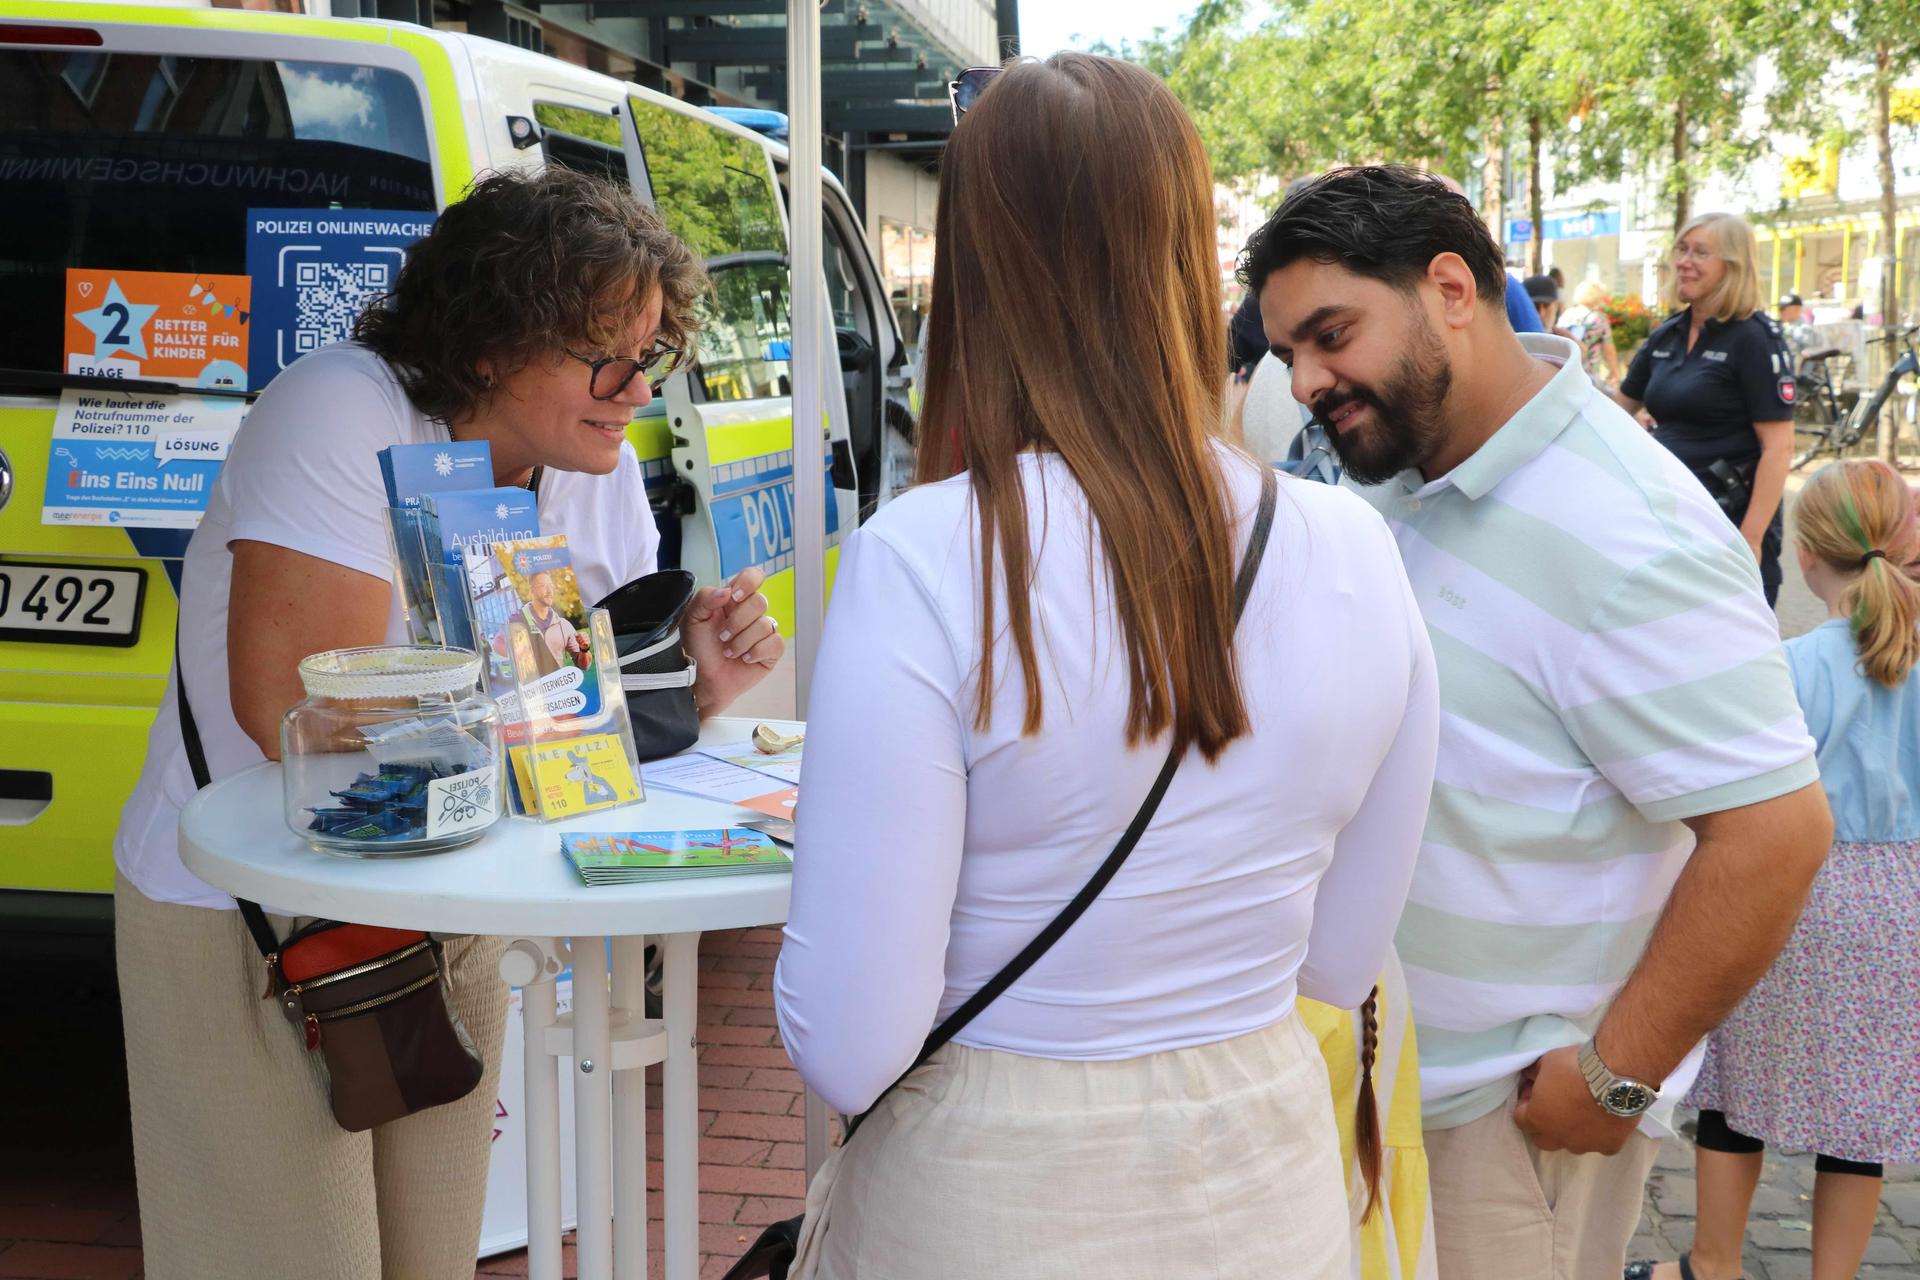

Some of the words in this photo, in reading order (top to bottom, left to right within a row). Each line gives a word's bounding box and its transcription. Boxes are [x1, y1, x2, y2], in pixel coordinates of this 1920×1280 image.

[255, 220, 312, 235] POLIZEI
[316, 220, 431, 237] ONLINEWACHE
[101, 302, 130, 345] 2
[154, 318, 208, 332] RETTER
[153, 332, 207, 347] RALLYE
[212, 332, 240, 347] FÜR
[153, 346, 206, 360] KINDER
[79, 366, 124, 379] FRAGE
[78, 397, 102, 408] Wie
[105, 398, 144, 410] lautet
[146, 401, 166, 410] die
[74, 409, 170, 424] Notrufnummer
[174, 413, 195, 424] der
[71, 422, 123, 435] Polizei?
[126, 424, 150, 435] 110
[166, 437, 220, 452] LÖSUNG
[68, 471, 110, 488] Eins
[115, 471, 157, 490] Eins
[163, 474, 204, 492] Null
[741, 483, 793, 564] POLI
[21, 574, 115, 625] 492
[551, 799, 568, 810] 110
